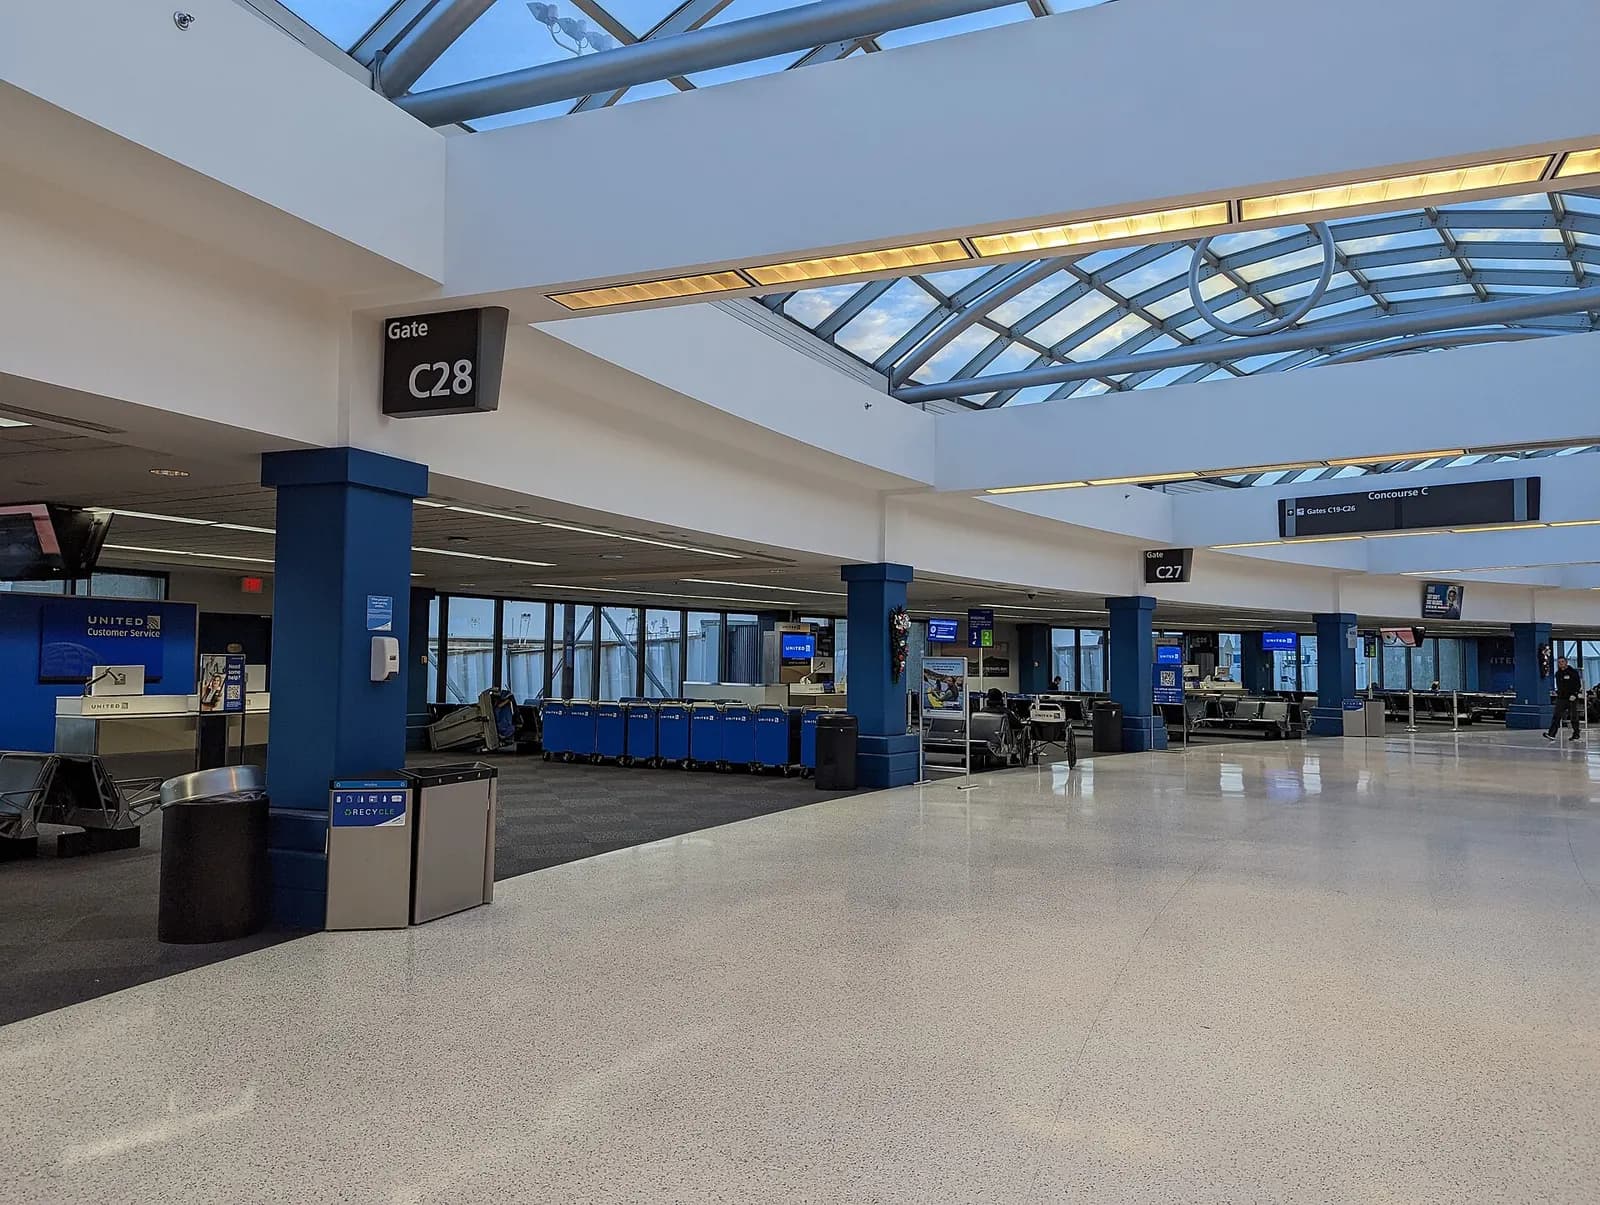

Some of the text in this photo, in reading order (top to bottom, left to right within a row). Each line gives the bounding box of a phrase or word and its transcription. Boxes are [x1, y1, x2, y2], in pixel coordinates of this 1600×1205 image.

[388, 321, 429, 339] Gate
[408, 359, 473, 398] C28
[1368, 487, 1429, 500] Concourse C
[1327, 504, 1356, 514] C19-C26
[1156, 566, 1182, 579] C27
[87, 615, 144, 626] UNITED
[87, 628, 161, 638] Customer Service
[983, 631, 990, 640] 2
[352, 808, 394, 816] RECYCLE
